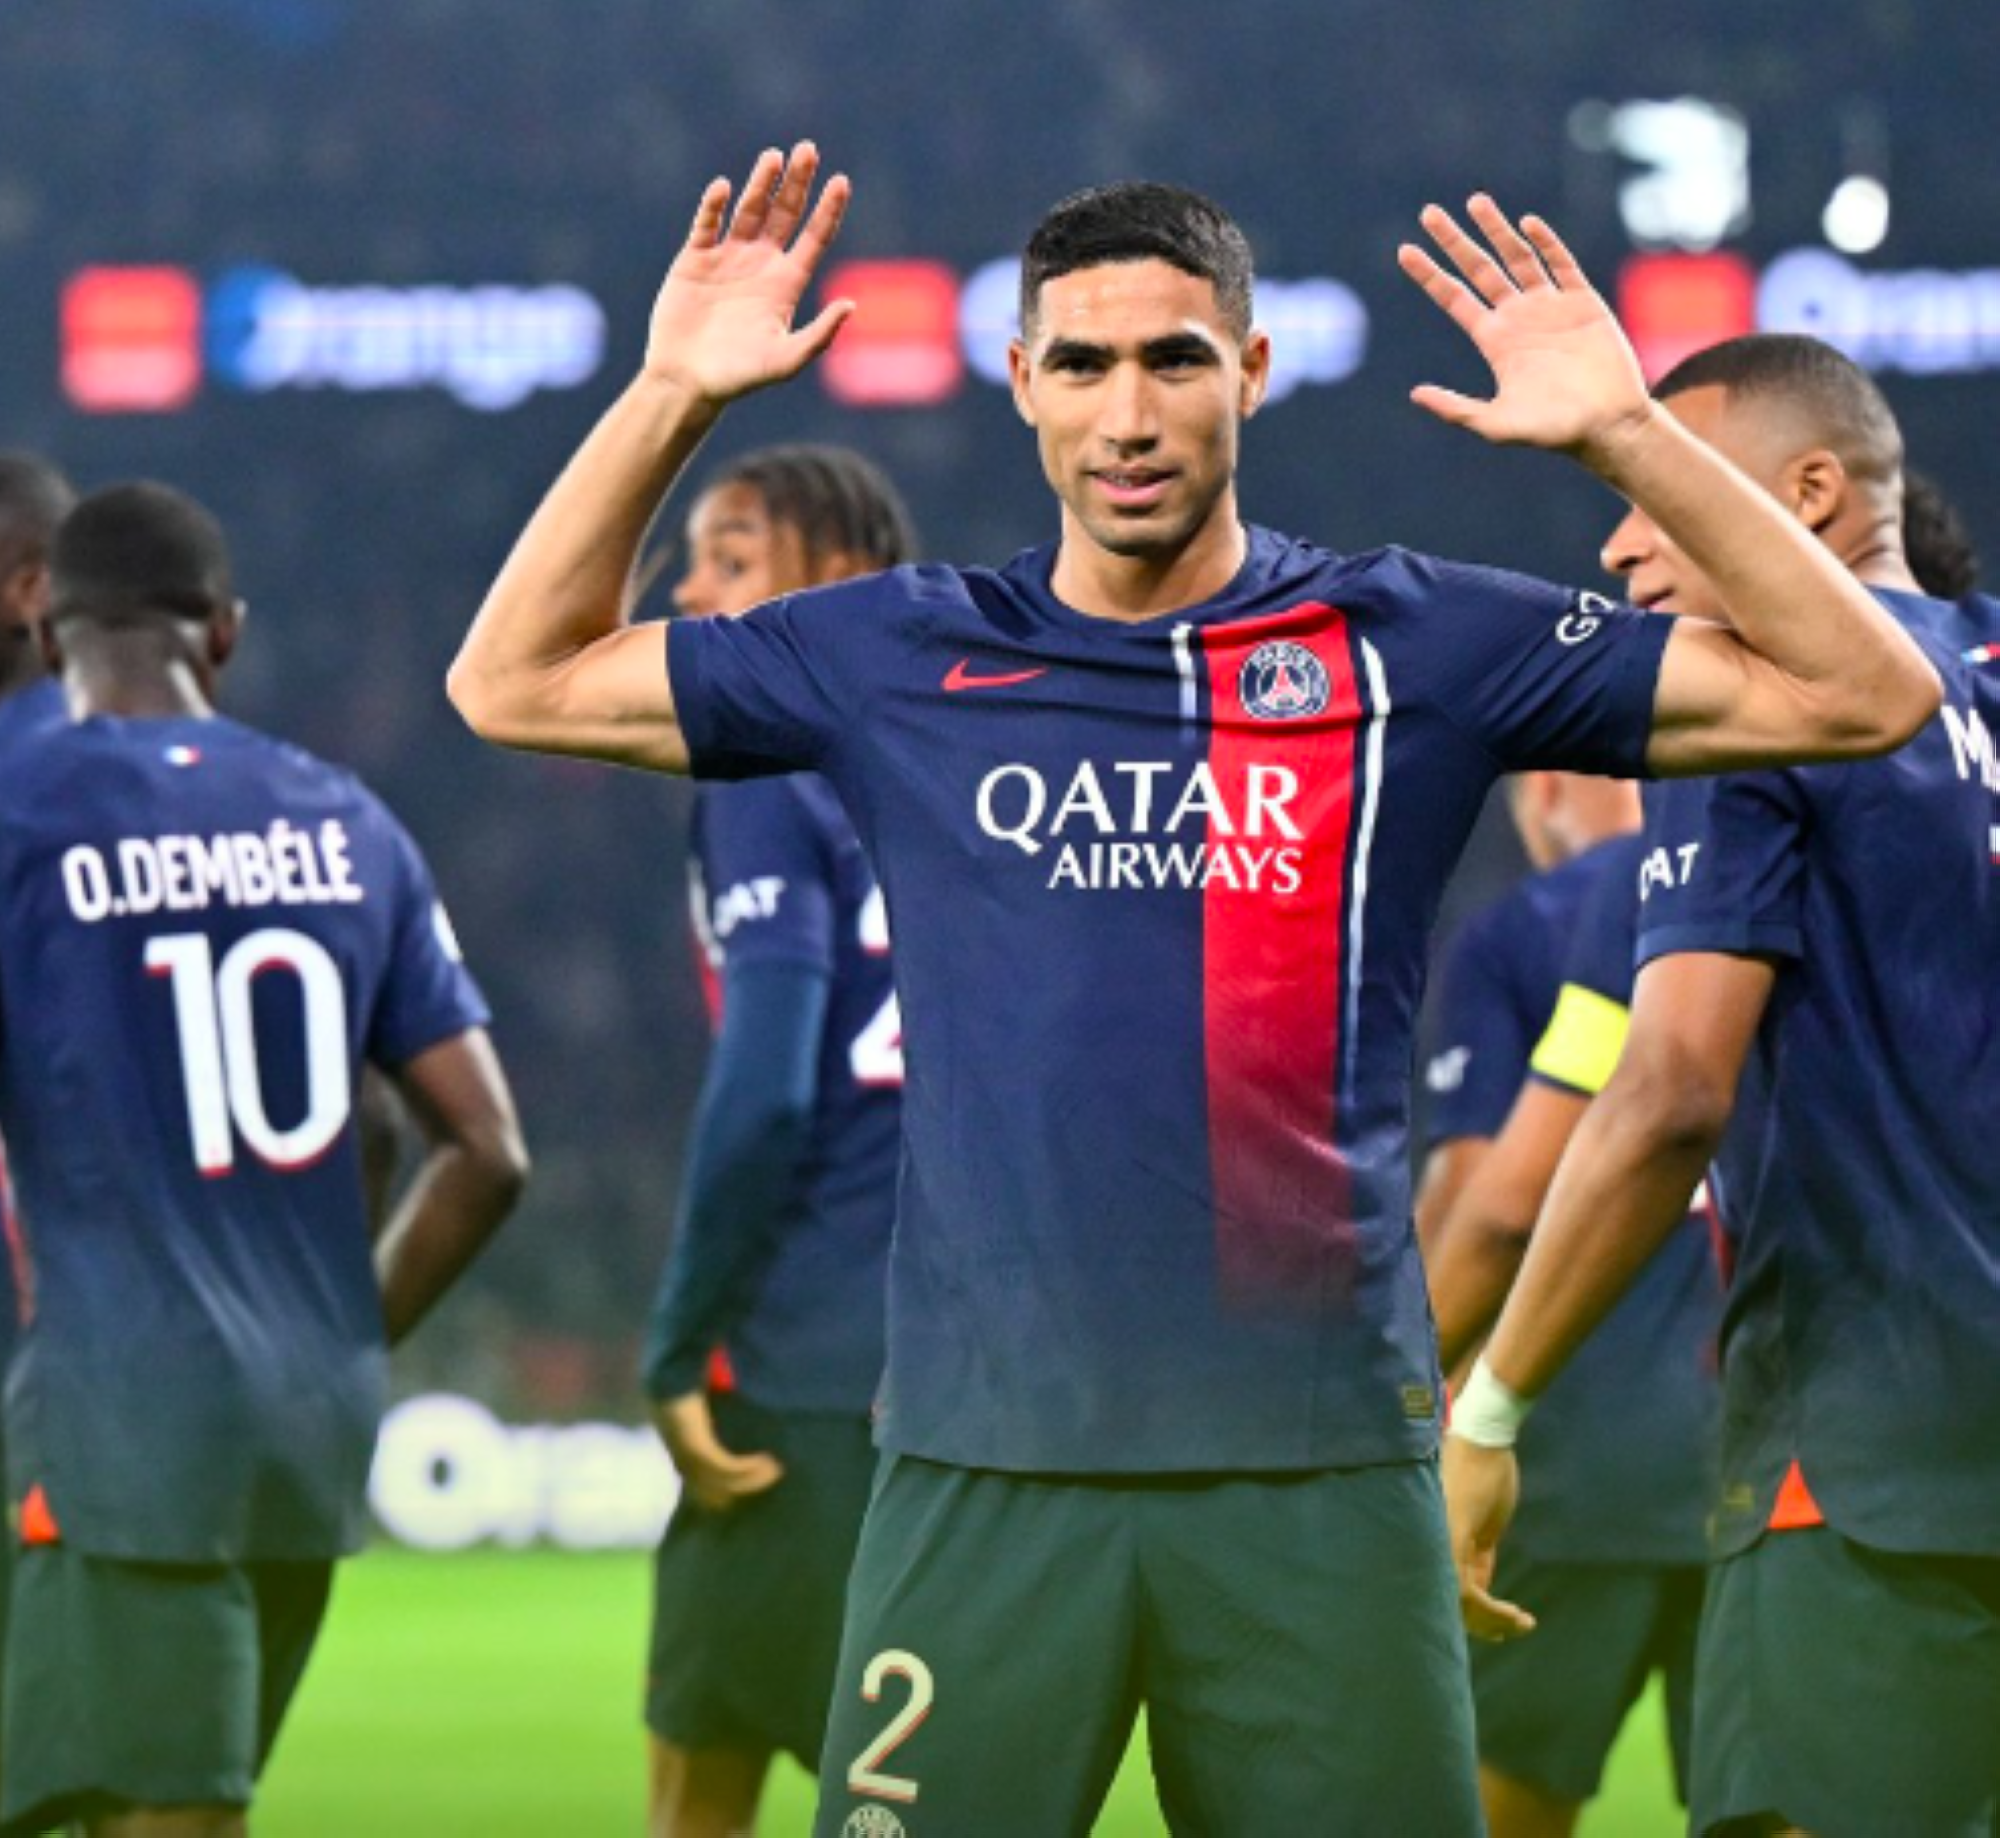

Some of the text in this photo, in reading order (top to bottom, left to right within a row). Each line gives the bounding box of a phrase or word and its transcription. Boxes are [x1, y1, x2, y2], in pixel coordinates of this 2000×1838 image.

[975, 760, 1303, 855] QATAR
[61, 818, 363, 922] O.DEMBÉLÉ
[1046, 842, 1303, 895] AIRWAYS
[143, 927, 351, 1178] 10
[847, 1648, 935, 1804] 2
